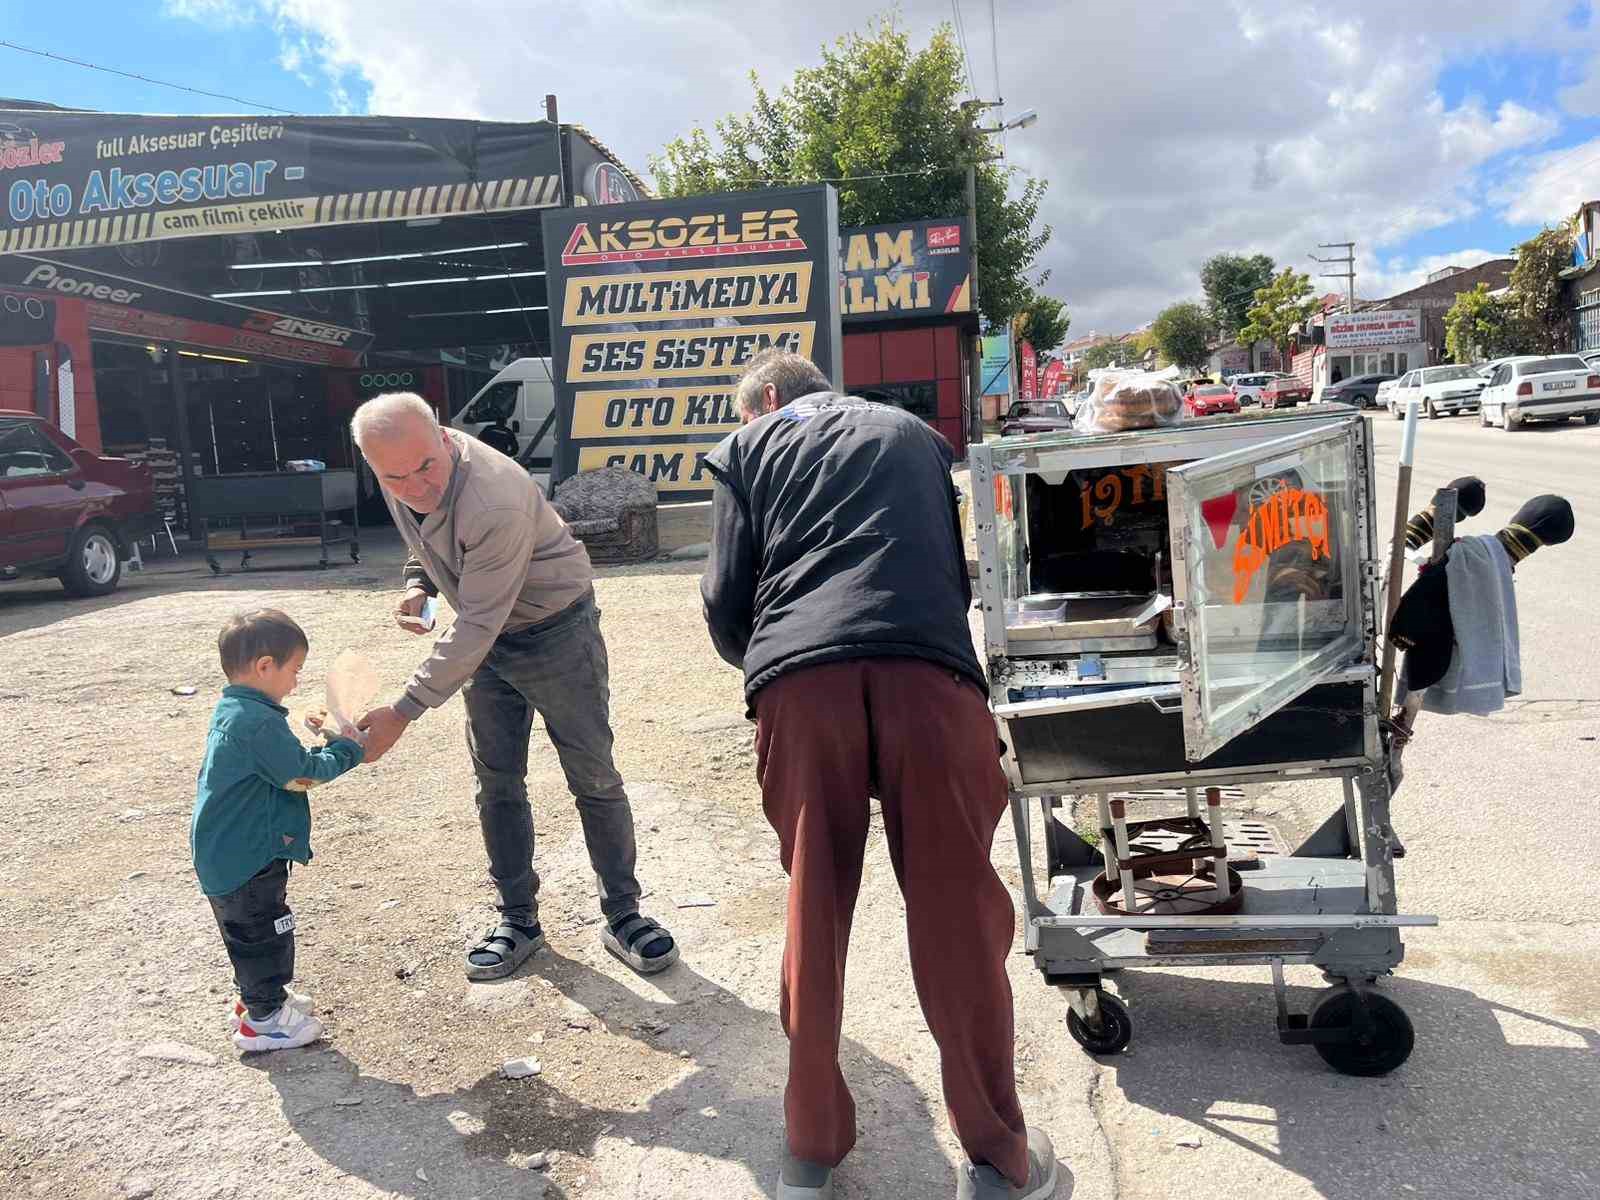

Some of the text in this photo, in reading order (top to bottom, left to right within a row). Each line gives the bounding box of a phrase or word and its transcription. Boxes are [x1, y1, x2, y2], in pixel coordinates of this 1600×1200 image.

[96, 121, 284, 159] full Aksesuar Çeşitleri
[9, 179, 73, 222] Oto
[80, 159, 277, 214] Aksesuar
[163, 202, 305, 230] cam filmi çekilir
[601, 242, 792, 261] OTO AKSESUAR
[839, 229, 914, 272] AM
[22, 264, 143, 304] Pioneer
[582, 340, 647, 373] SES
[604, 394, 740, 428] OTO KIL
